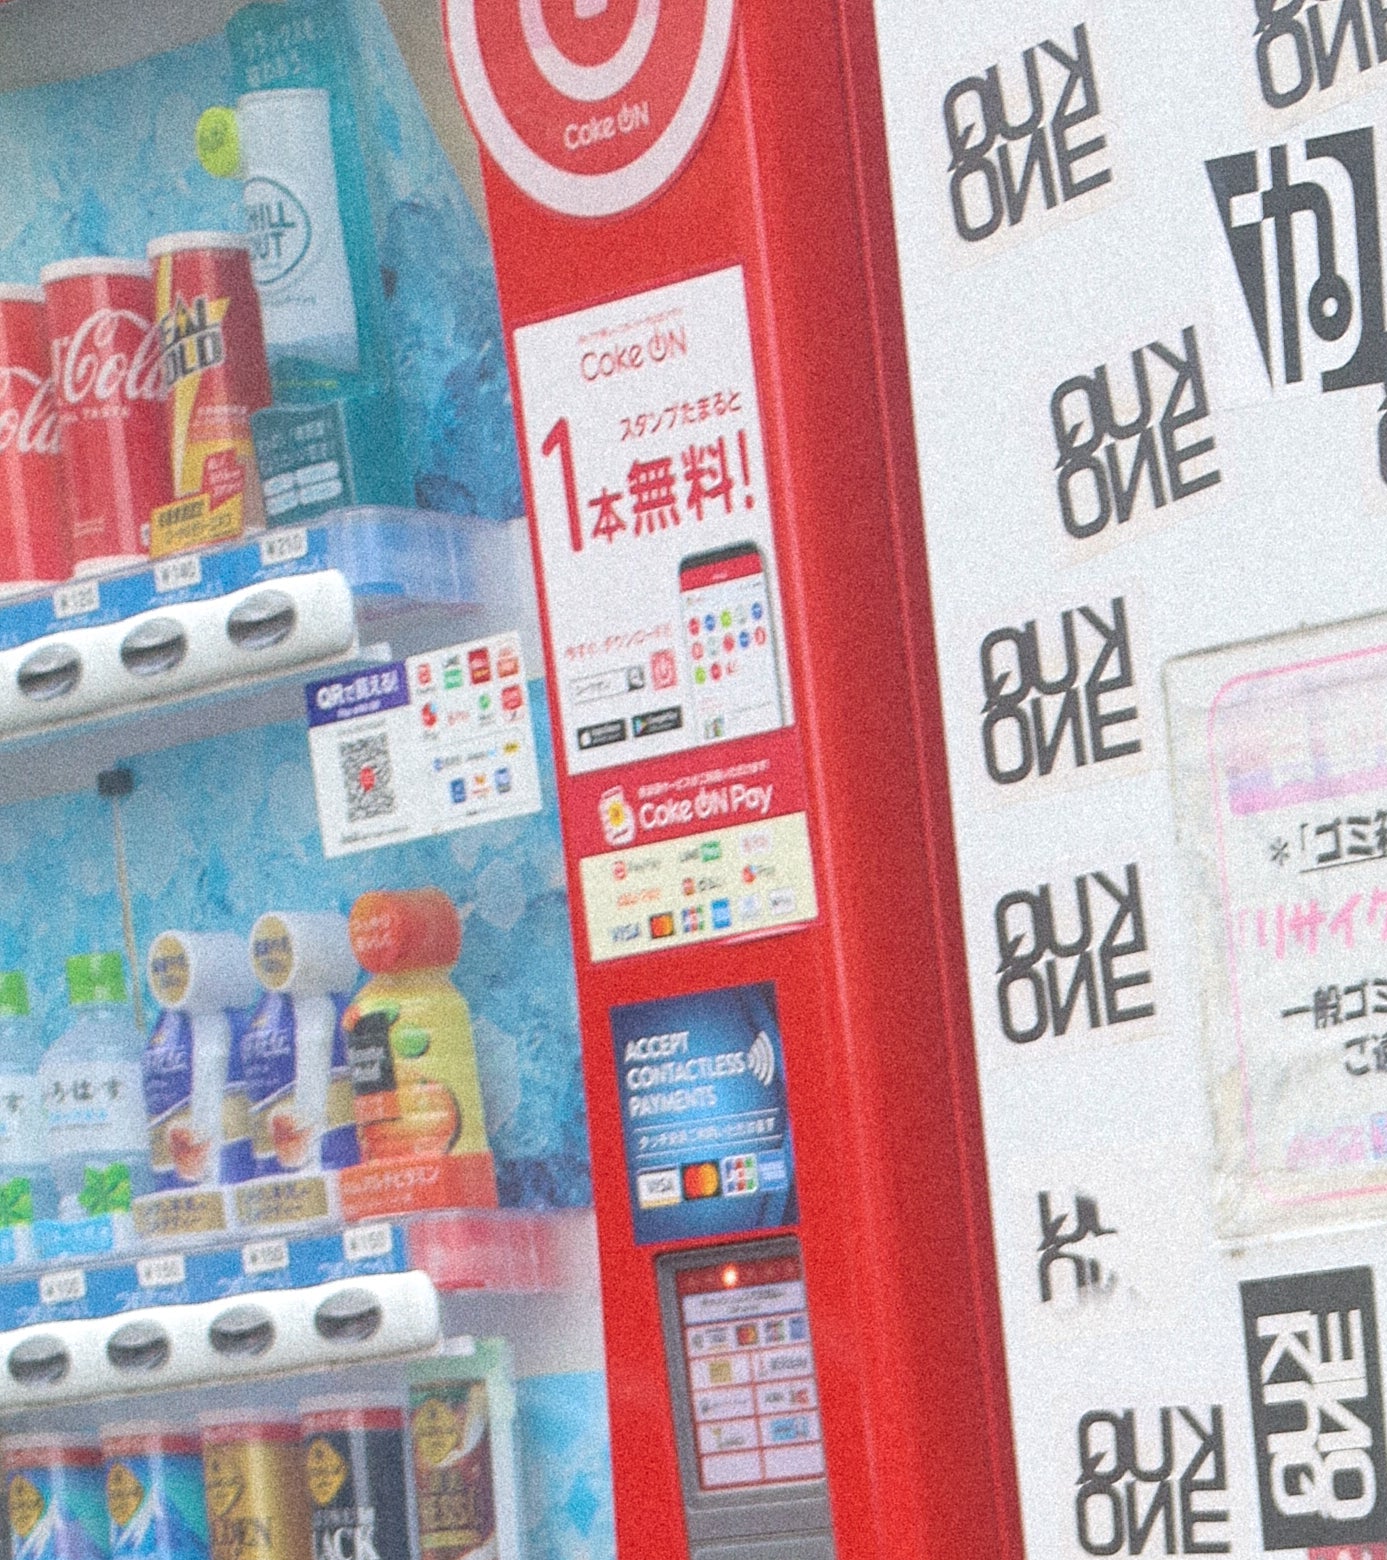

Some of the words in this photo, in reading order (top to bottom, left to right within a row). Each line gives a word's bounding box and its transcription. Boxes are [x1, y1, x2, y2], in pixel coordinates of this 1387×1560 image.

[564, 120, 614, 150] Coke
[616, 103, 649, 137] ON
[579, 345, 644, 382] Coke
[648, 326, 688, 362] ON
[619, 390, 743, 442] スタンプたまると
[638, 798, 694, 831] Coke
[695, 788, 731, 821] ON
[731, 783, 775, 814] Pay
[625, 1031, 690, 1064] ACCEPT
[625, 1051, 747, 1091] CONTACTLESS
[628, 1084, 718, 1119] PAYMENTS
